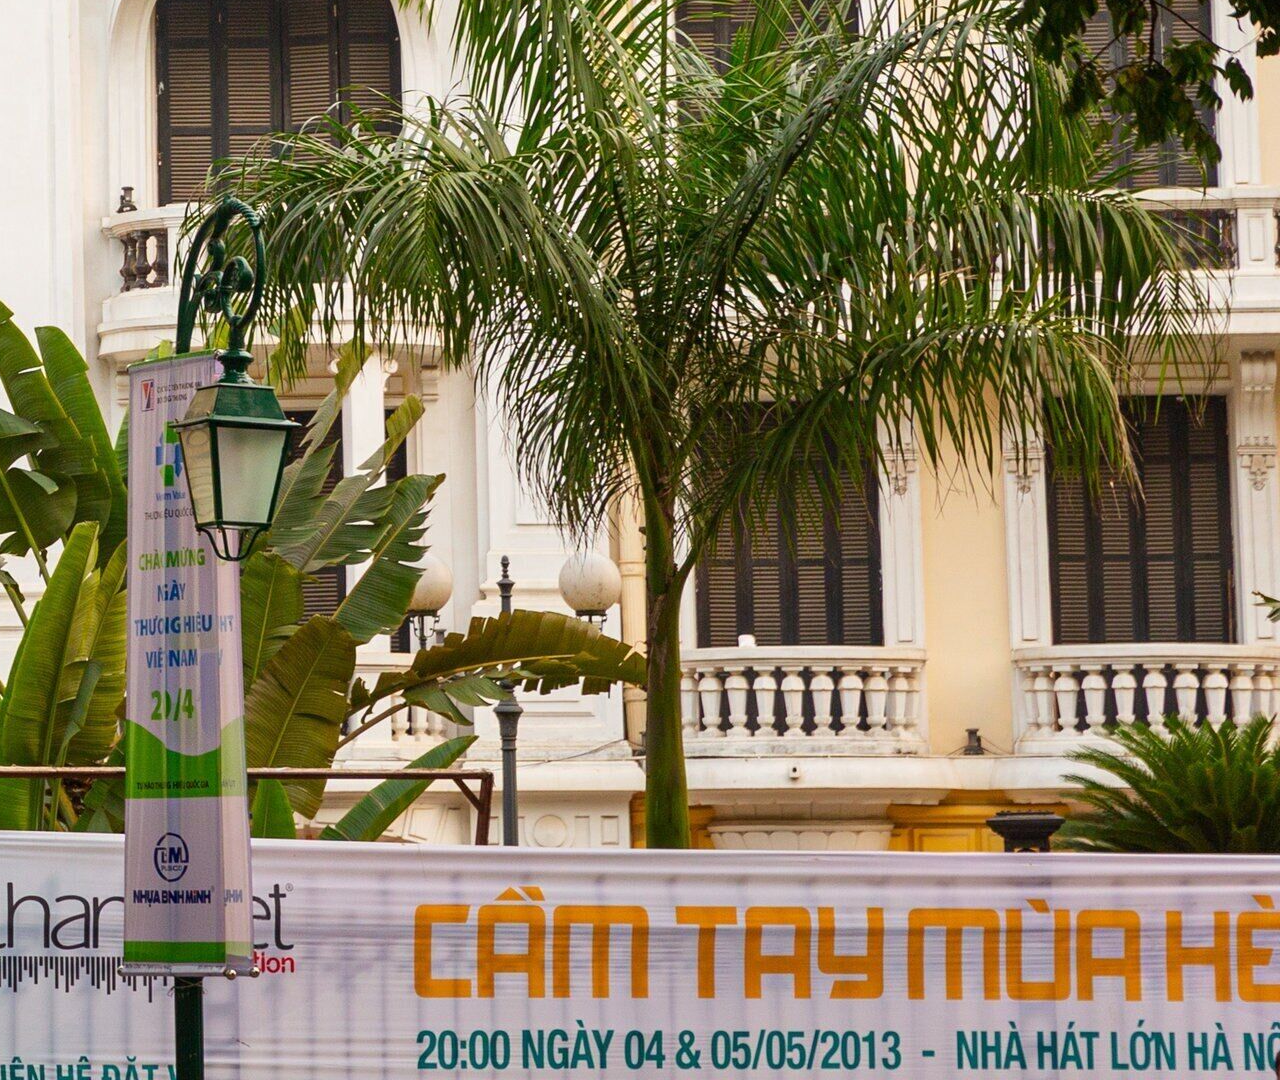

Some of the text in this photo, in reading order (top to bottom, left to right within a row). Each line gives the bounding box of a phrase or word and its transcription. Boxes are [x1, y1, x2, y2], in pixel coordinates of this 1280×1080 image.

[138, 549, 165, 571] CHÀ
[145, 648, 198, 672] VIỆ NAM
[675, 905, 885, 1000] TAY
[907, 898, 1142, 1002] MÙA
[1166, 894, 1280, 1003] HÈ
[416, 1029, 511, 1071] 20:00
[521, 1019, 614, 1070] NGÀY
[624, 1029, 666, 1071] 04
[675, 1029, 702, 1071] &
[710, 1028, 902, 1071] 05/05/2013
[956, 1020, 1028, 1071] NHÀ
[1037, 1020, 1100, 1071] HÁT
[1110, 1019, 1176, 1071] LỚN
[1188, 1021, 1234, 1071] HÀ
